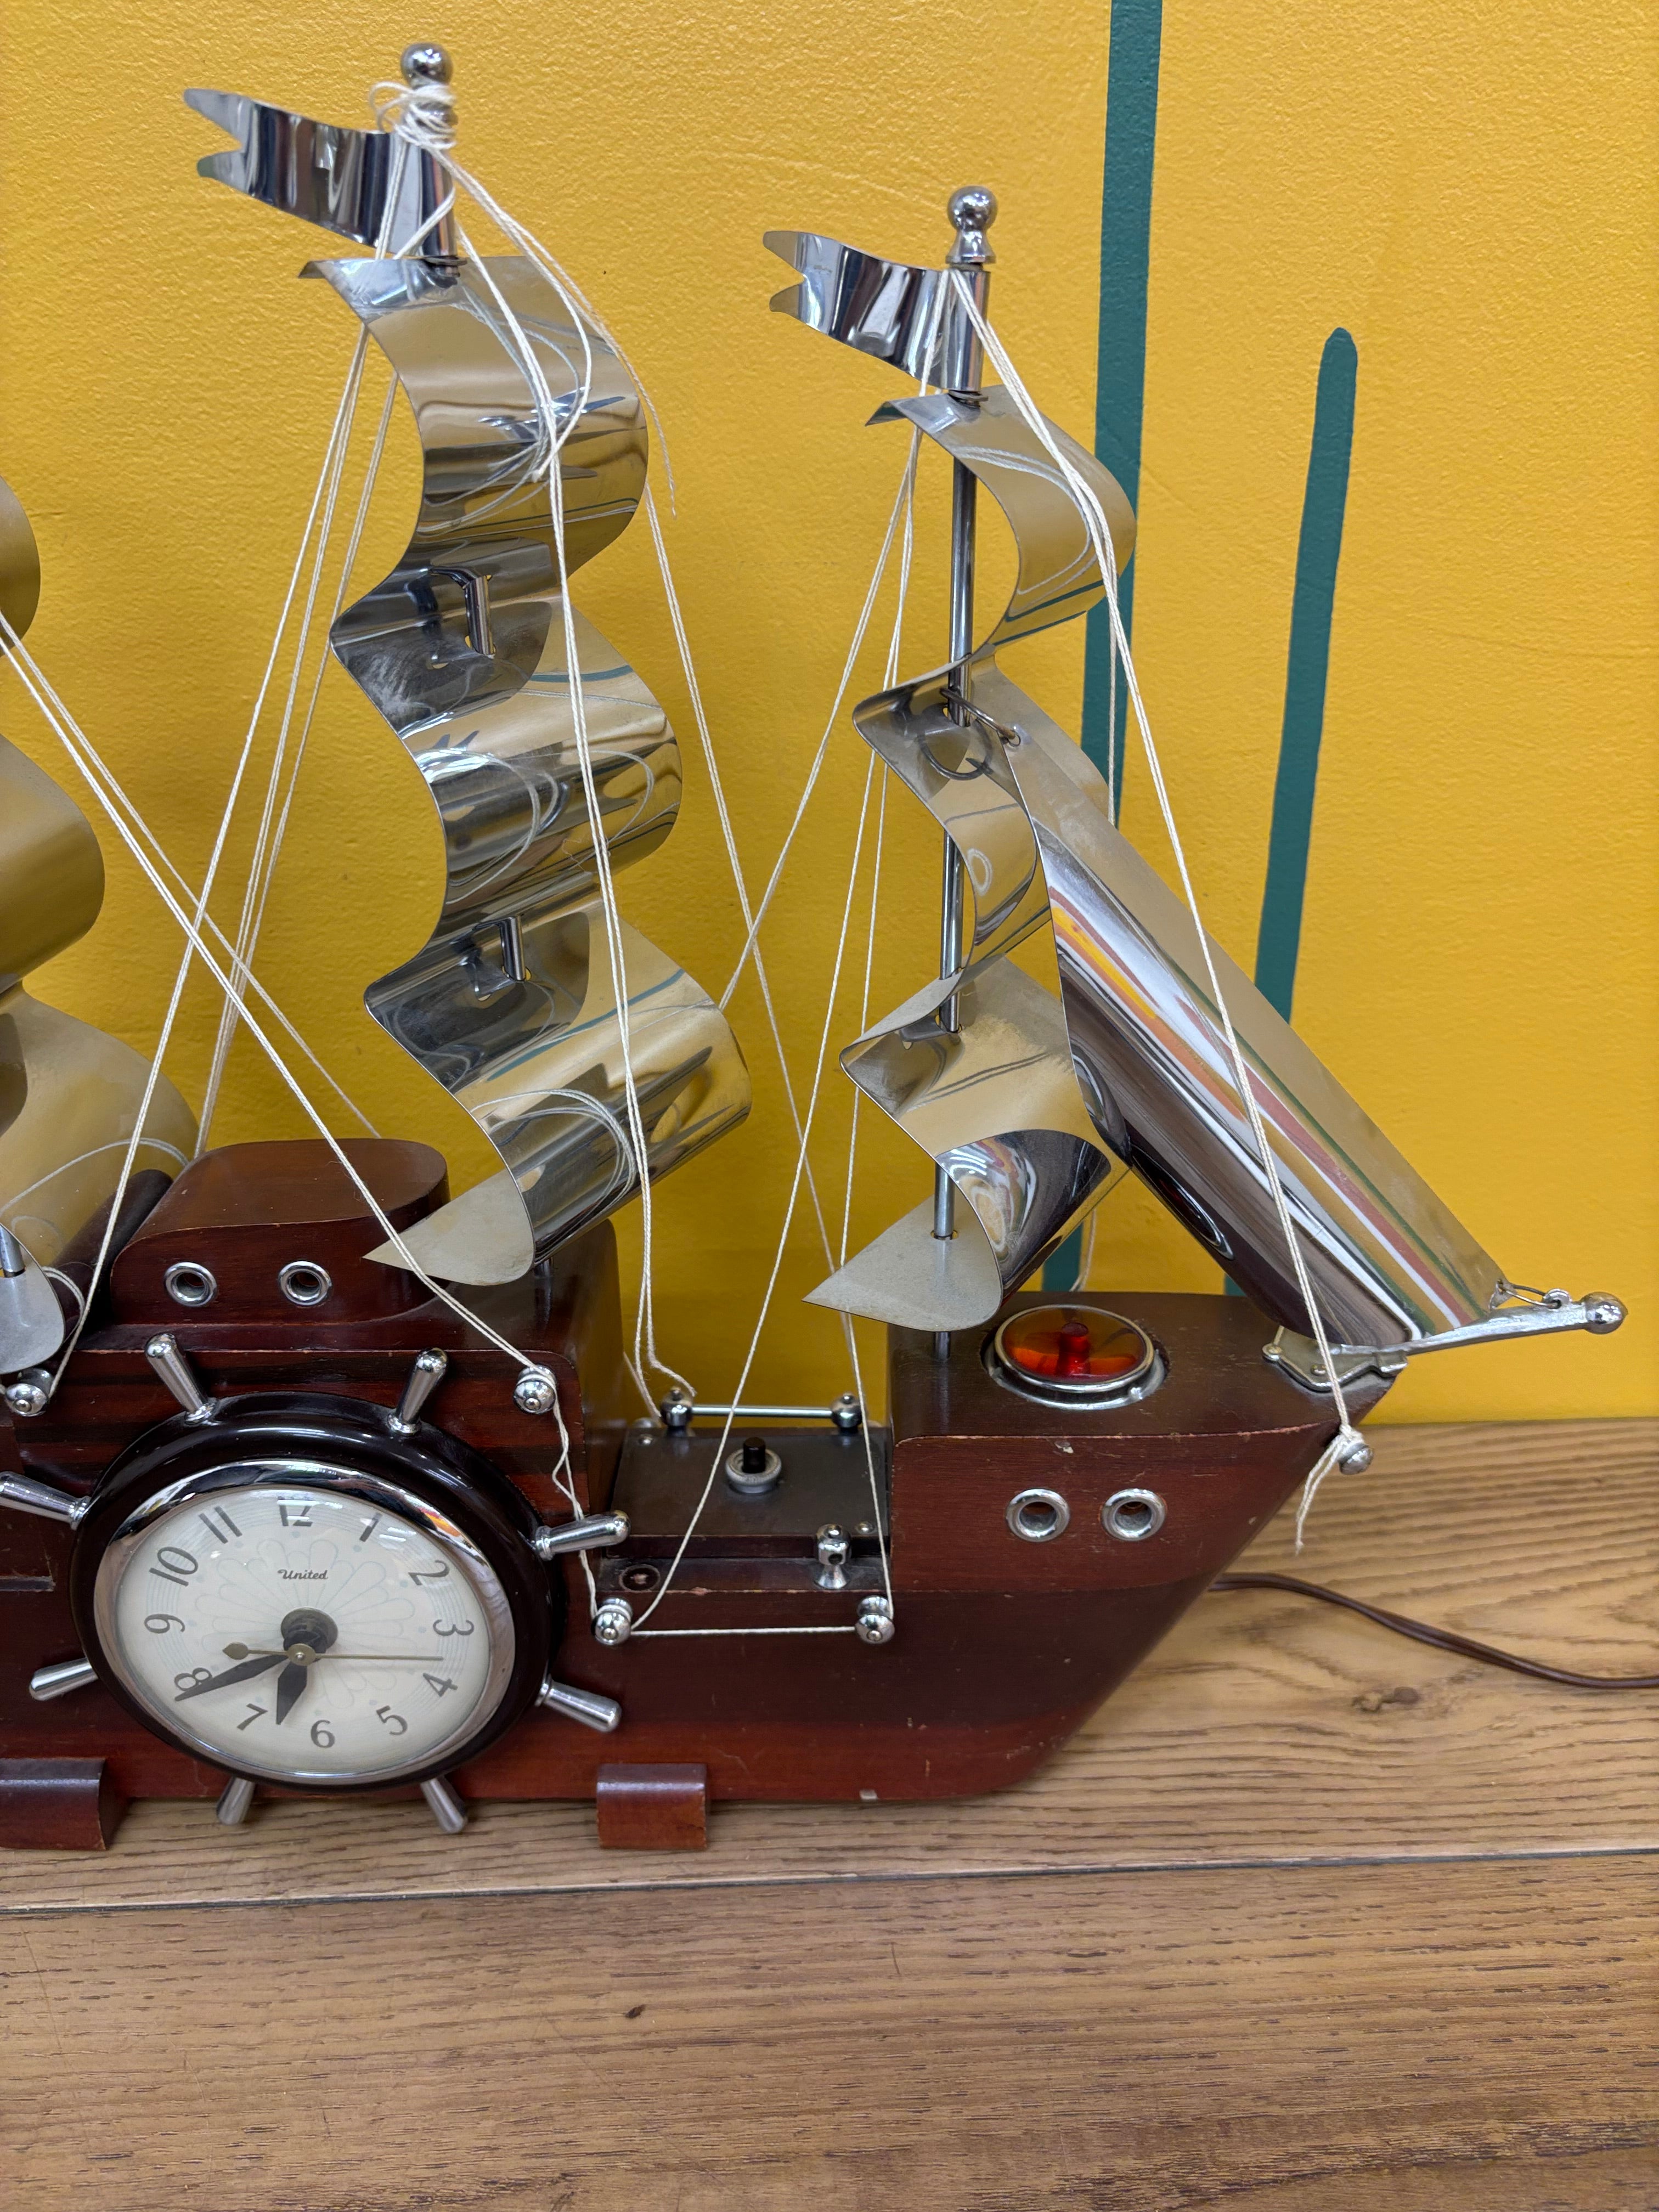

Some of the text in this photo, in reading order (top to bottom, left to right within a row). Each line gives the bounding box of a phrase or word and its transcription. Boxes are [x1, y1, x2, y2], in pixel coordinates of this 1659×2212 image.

[198, 1506, 242, 1544] 11
[359, 1512, 382, 1542] 1
[149, 1546, 199, 1587] 10
[277, 1569, 329, 1580] United
[408, 1560, 450, 1585] 2
[144, 1613, 185, 1634] 9
[432, 1620, 474, 1636] 3
[174, 1667, 213, 1692] 8
[422, 1673, 458, 1697] 4
[236, 1703, 268, 1731] 7
[376, 1705, 408, 1735] 5
[311, 1719, 335, 1748] 6
